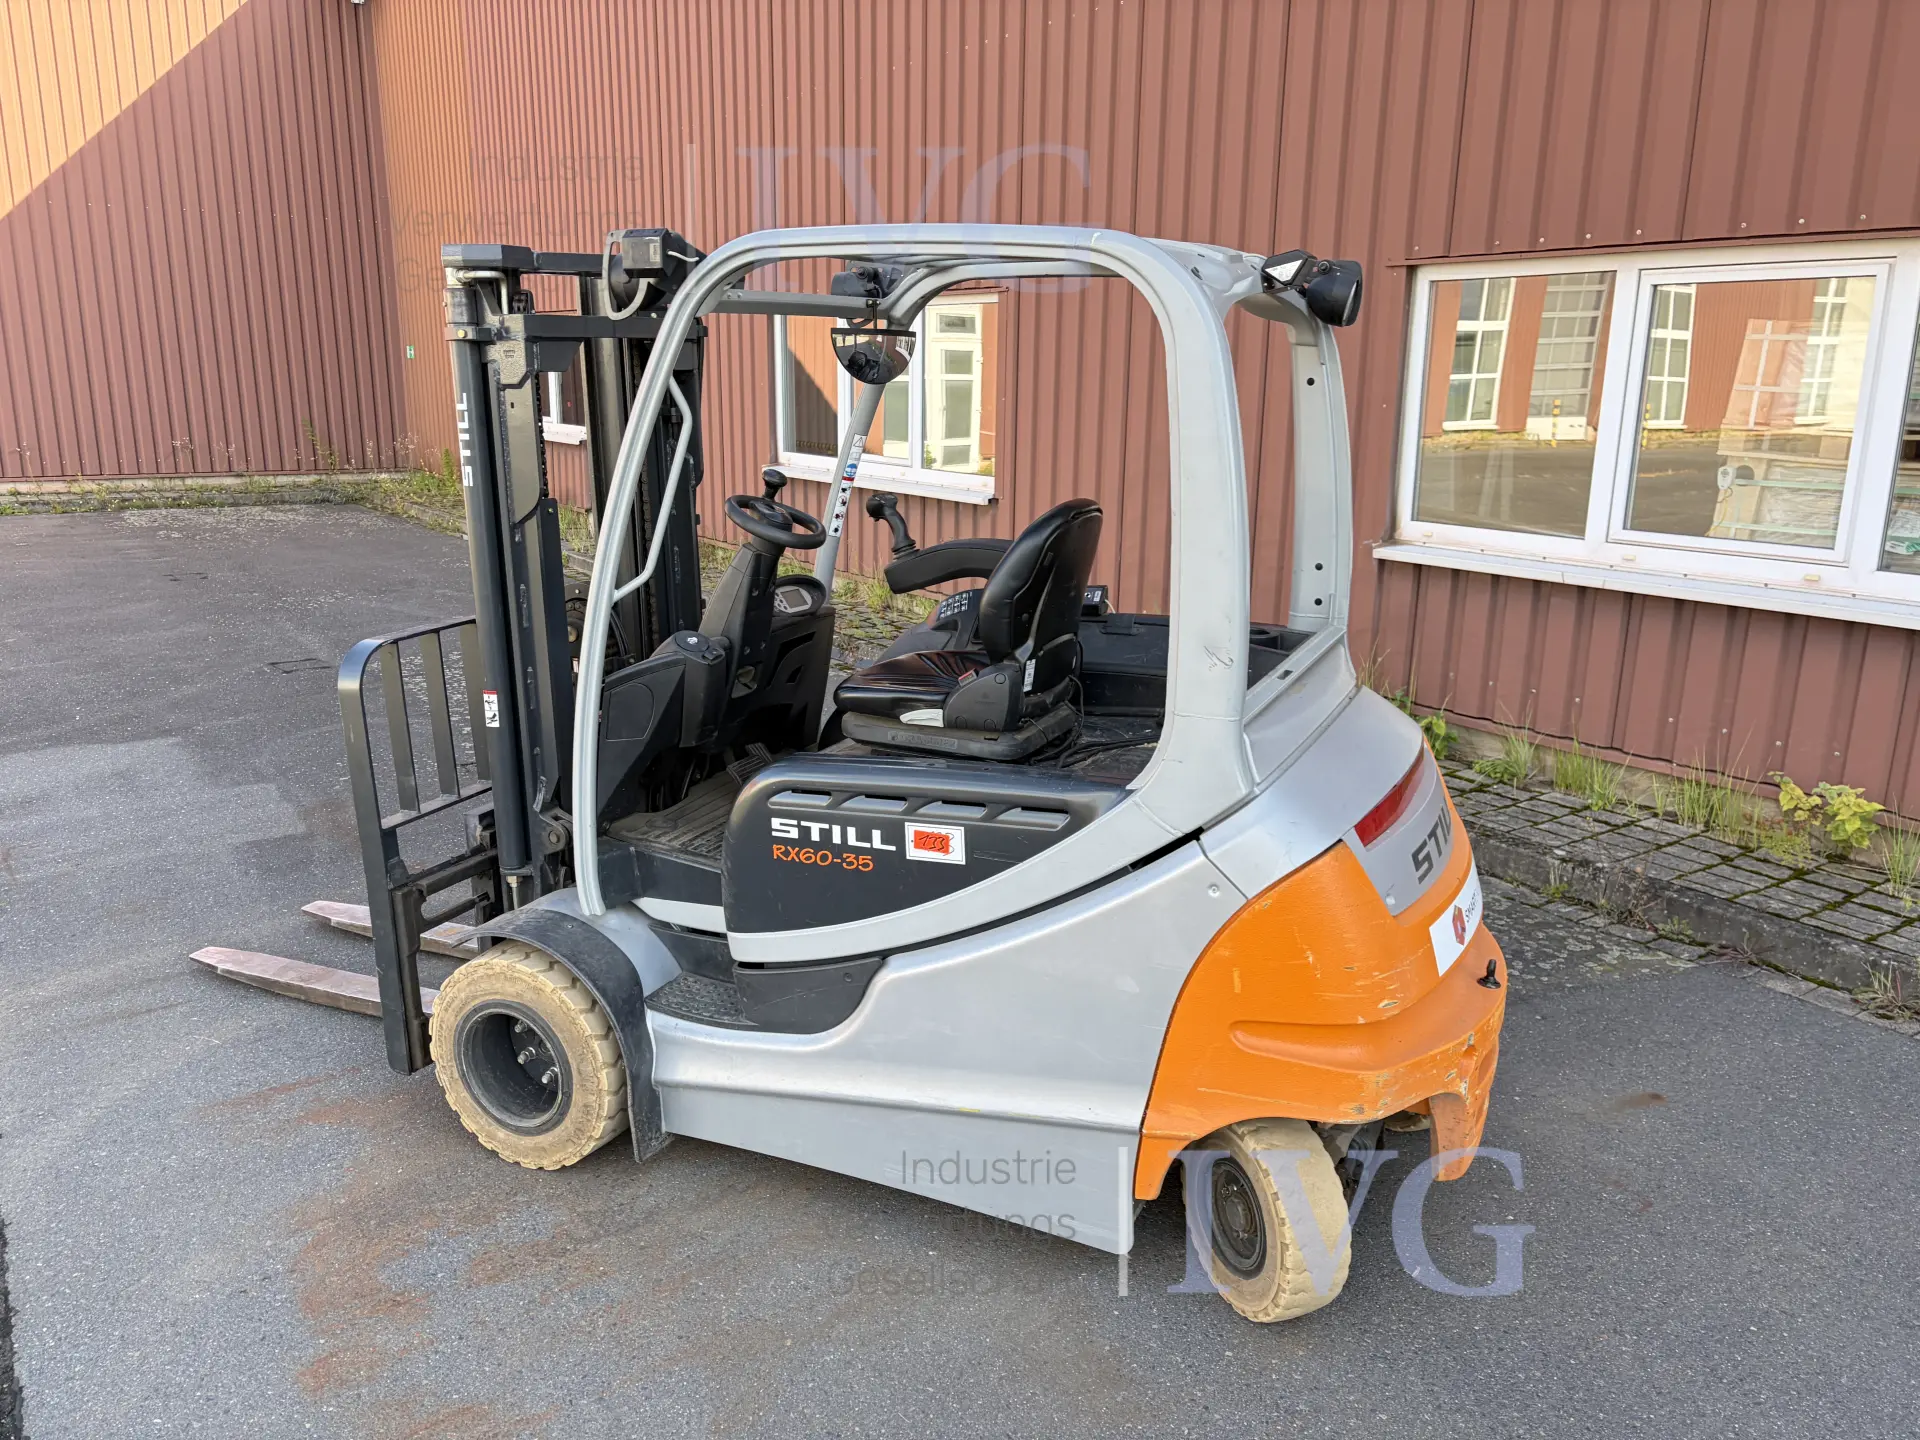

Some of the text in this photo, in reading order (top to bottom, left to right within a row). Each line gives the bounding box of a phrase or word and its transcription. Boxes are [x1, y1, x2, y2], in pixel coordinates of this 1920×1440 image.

[456, 392, 474, 487] STILL
[770, 817, 897, 852] STILL
[772, 844, 874, 872] RX60-35
